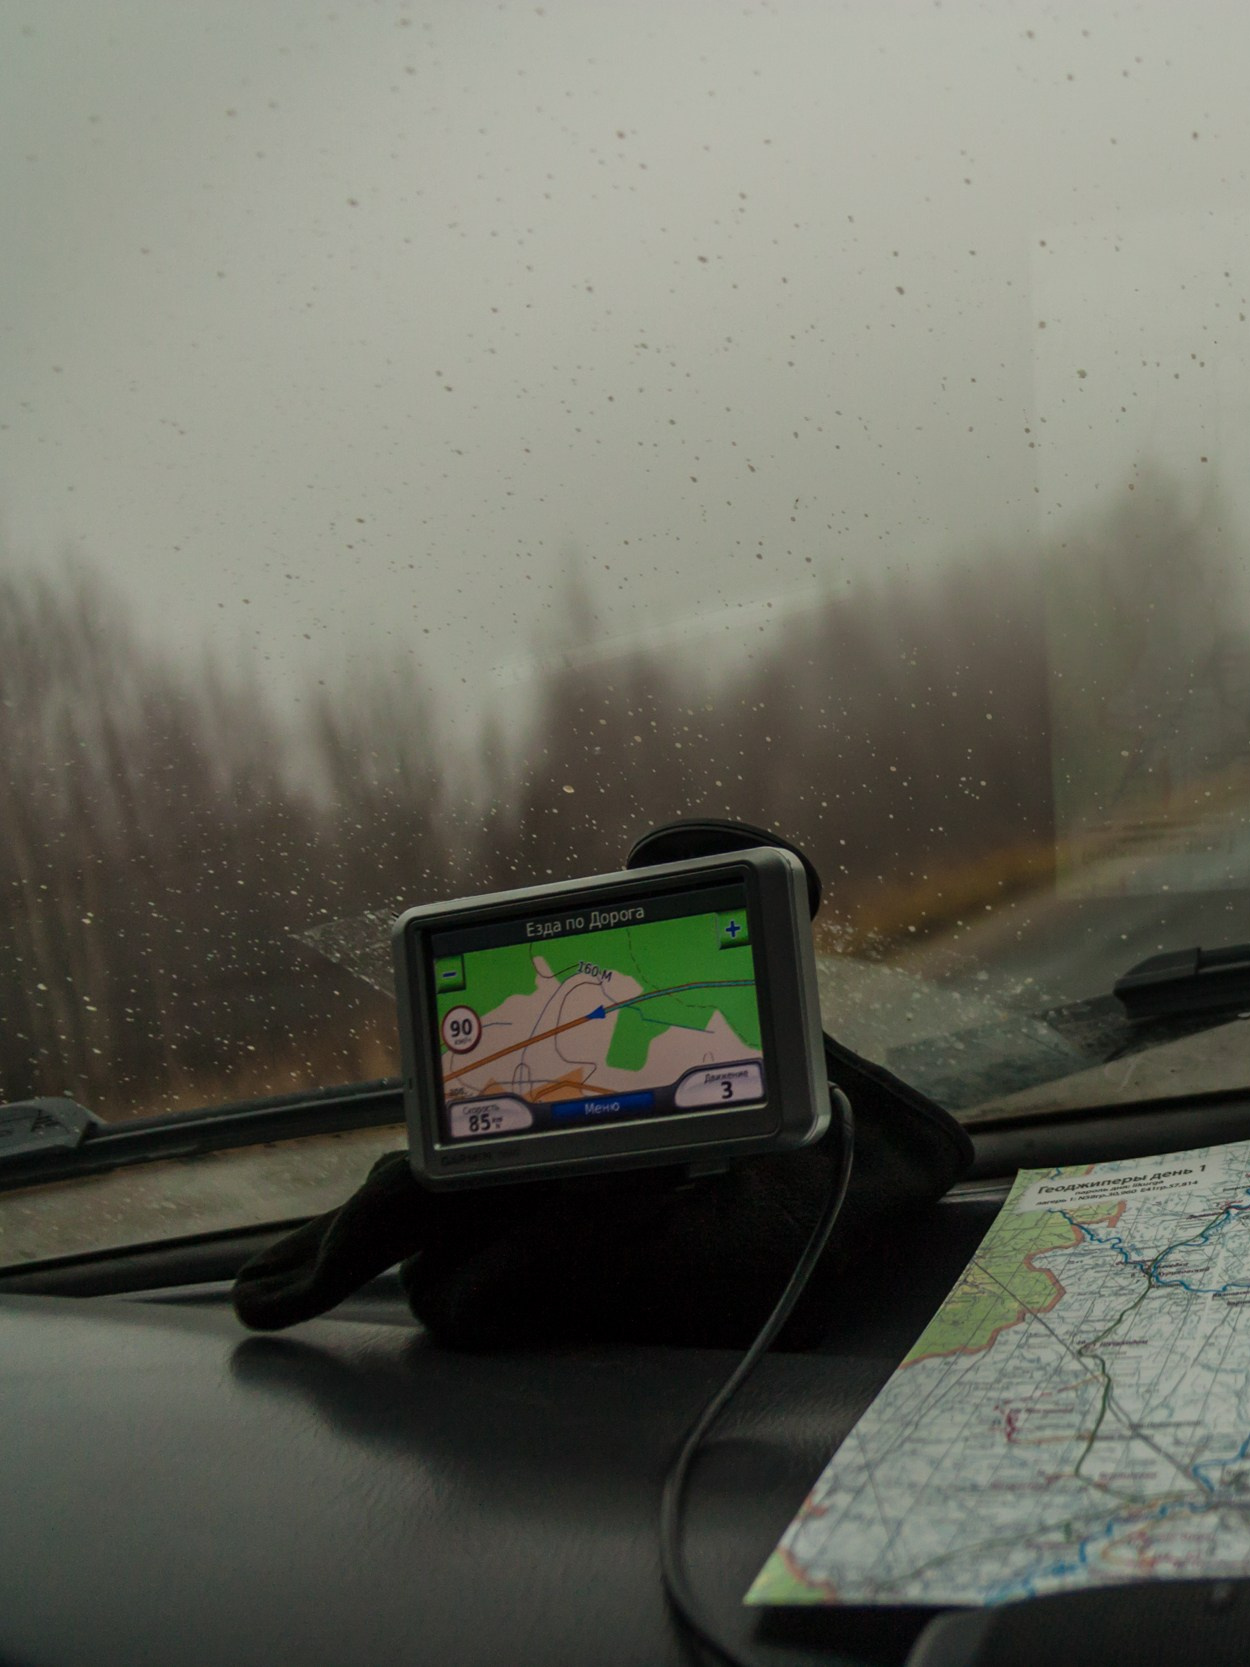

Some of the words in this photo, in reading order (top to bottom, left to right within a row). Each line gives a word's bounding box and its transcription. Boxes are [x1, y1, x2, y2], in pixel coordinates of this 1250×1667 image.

[526, 921, 561, 937] Езда
[566, 917, 585, 930] по
[589, 906, 645, 930] Дорога
[577, 961, 599, 977] 160
[450, 1018, 472, 1037] 90
[704, 1070, 749, 1084] Движение
[721, 1081, 733, 1099] 3
[463, 1104, 500, 1115] Скорость
[585, 1101, 620, 1115] Меню
[469, 1113, 491, 1132] 85
[1037, 1174, 1147, 1195] Геоджиперы
[1149, 1167, 1193, 1181] день
[1199, 1163, 1207, 1173] 1
